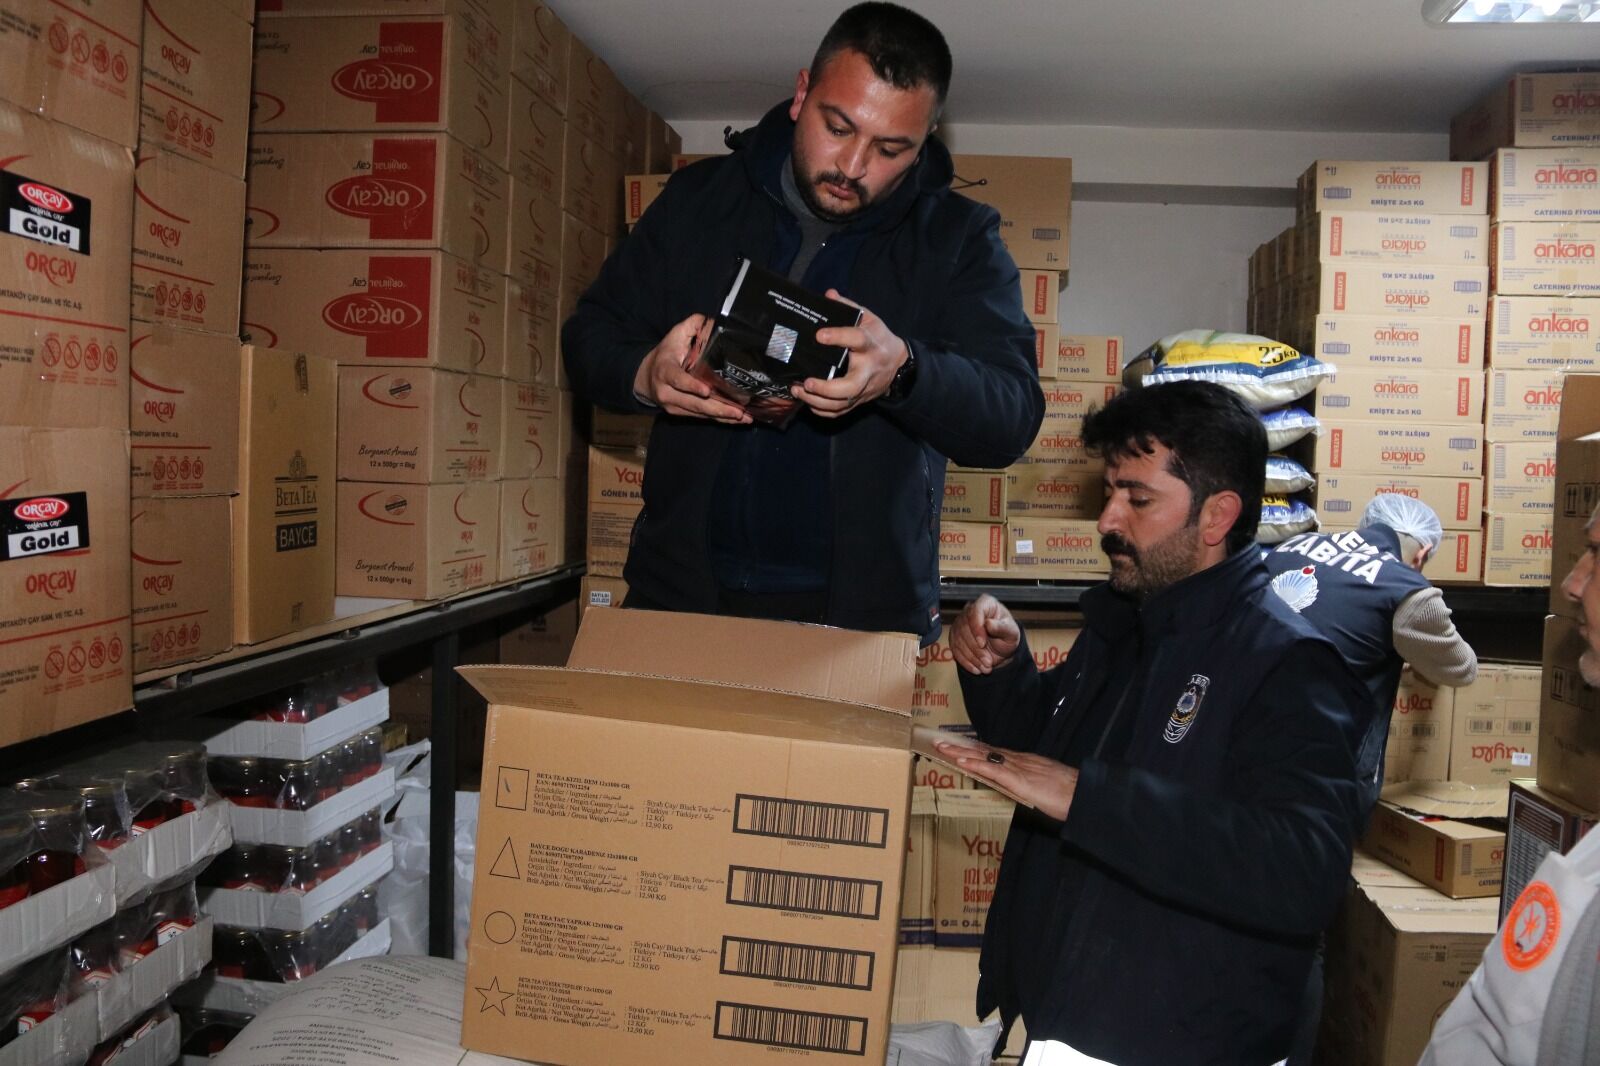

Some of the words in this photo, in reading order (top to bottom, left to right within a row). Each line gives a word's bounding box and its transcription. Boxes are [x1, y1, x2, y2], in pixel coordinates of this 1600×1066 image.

[1376, 168, 1421, 185] ankara
[1535, 164, 1598, 183] ankara
[22, 218, 70, 244] Gold
[1382, 239, 1426, 254] ankara
[1534, 239, 1595, 258] ankara
[1385, 294, 1430, 308] ankara
[1529, 313, 1589, 332] ankara
[1374, 326, 1419, 341] ankara
[1059, 342, 1085, 357] kara
[1374, 379, 1418, 393] ankara
[1382, 452, 1426, 466] ankara
[1524, 458, 1556, 476] ank
[602, 489, 627, 498] GÖNEN
[1037, 478, 1080, 494] ankara
[20, 532, 70, 552] Gold
[280, 524, 315, 548] BAYCE
[1046, 532, 1092, 548] ankara
[1522, 529, 1552, 548] ank
[916, 642, 954, 666] yla
[925, 691, 949, 708] Pirinç
[961, 834, 1003, 862] Yay
